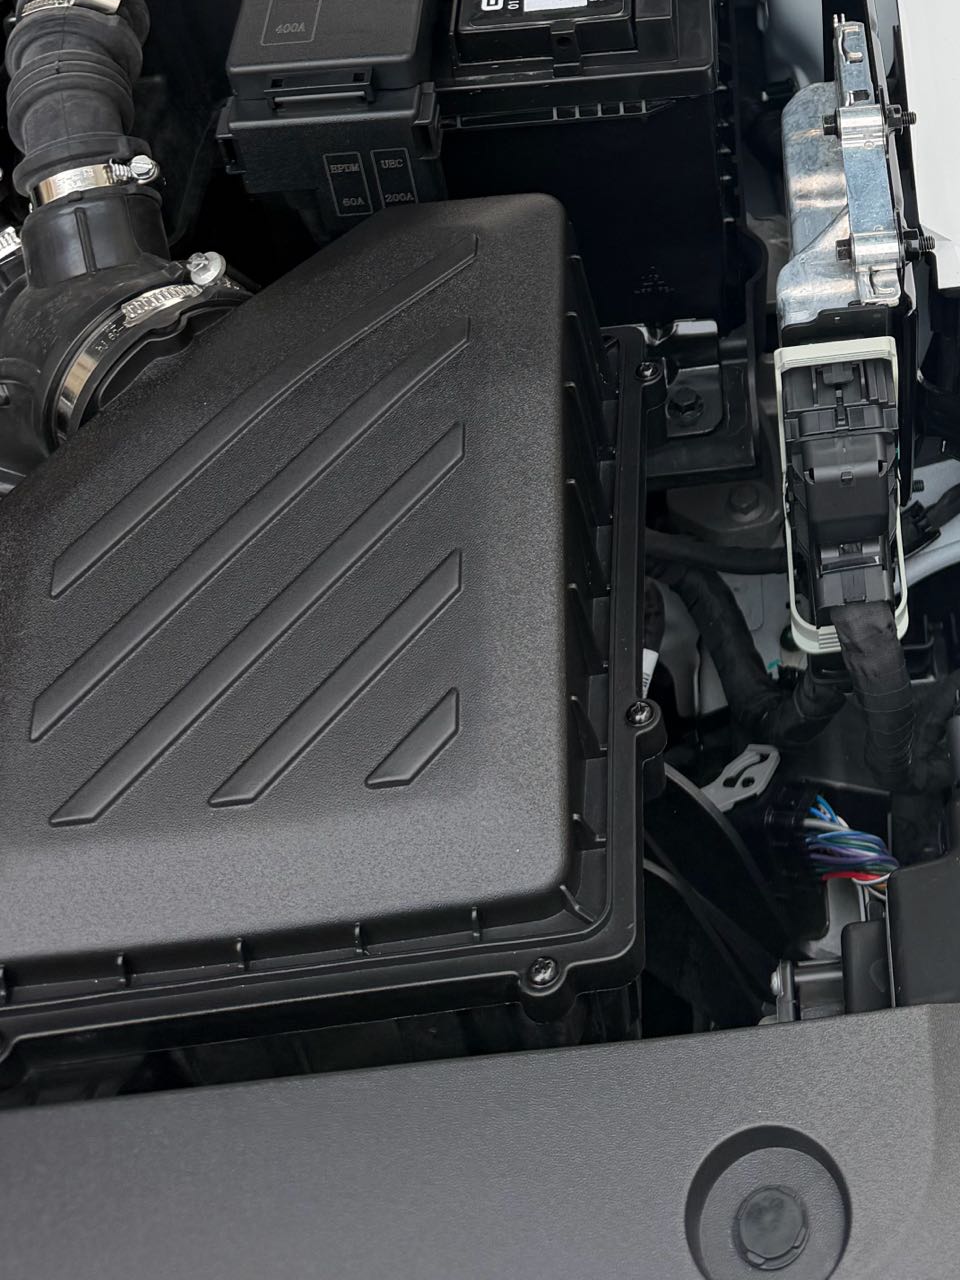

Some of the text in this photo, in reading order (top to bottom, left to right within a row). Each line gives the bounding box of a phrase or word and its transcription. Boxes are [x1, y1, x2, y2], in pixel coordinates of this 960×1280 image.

[276, 22, 306, 34] 400A
[342, 196, 366, 207] 60A
[384, 192, 414, 203] 200A
